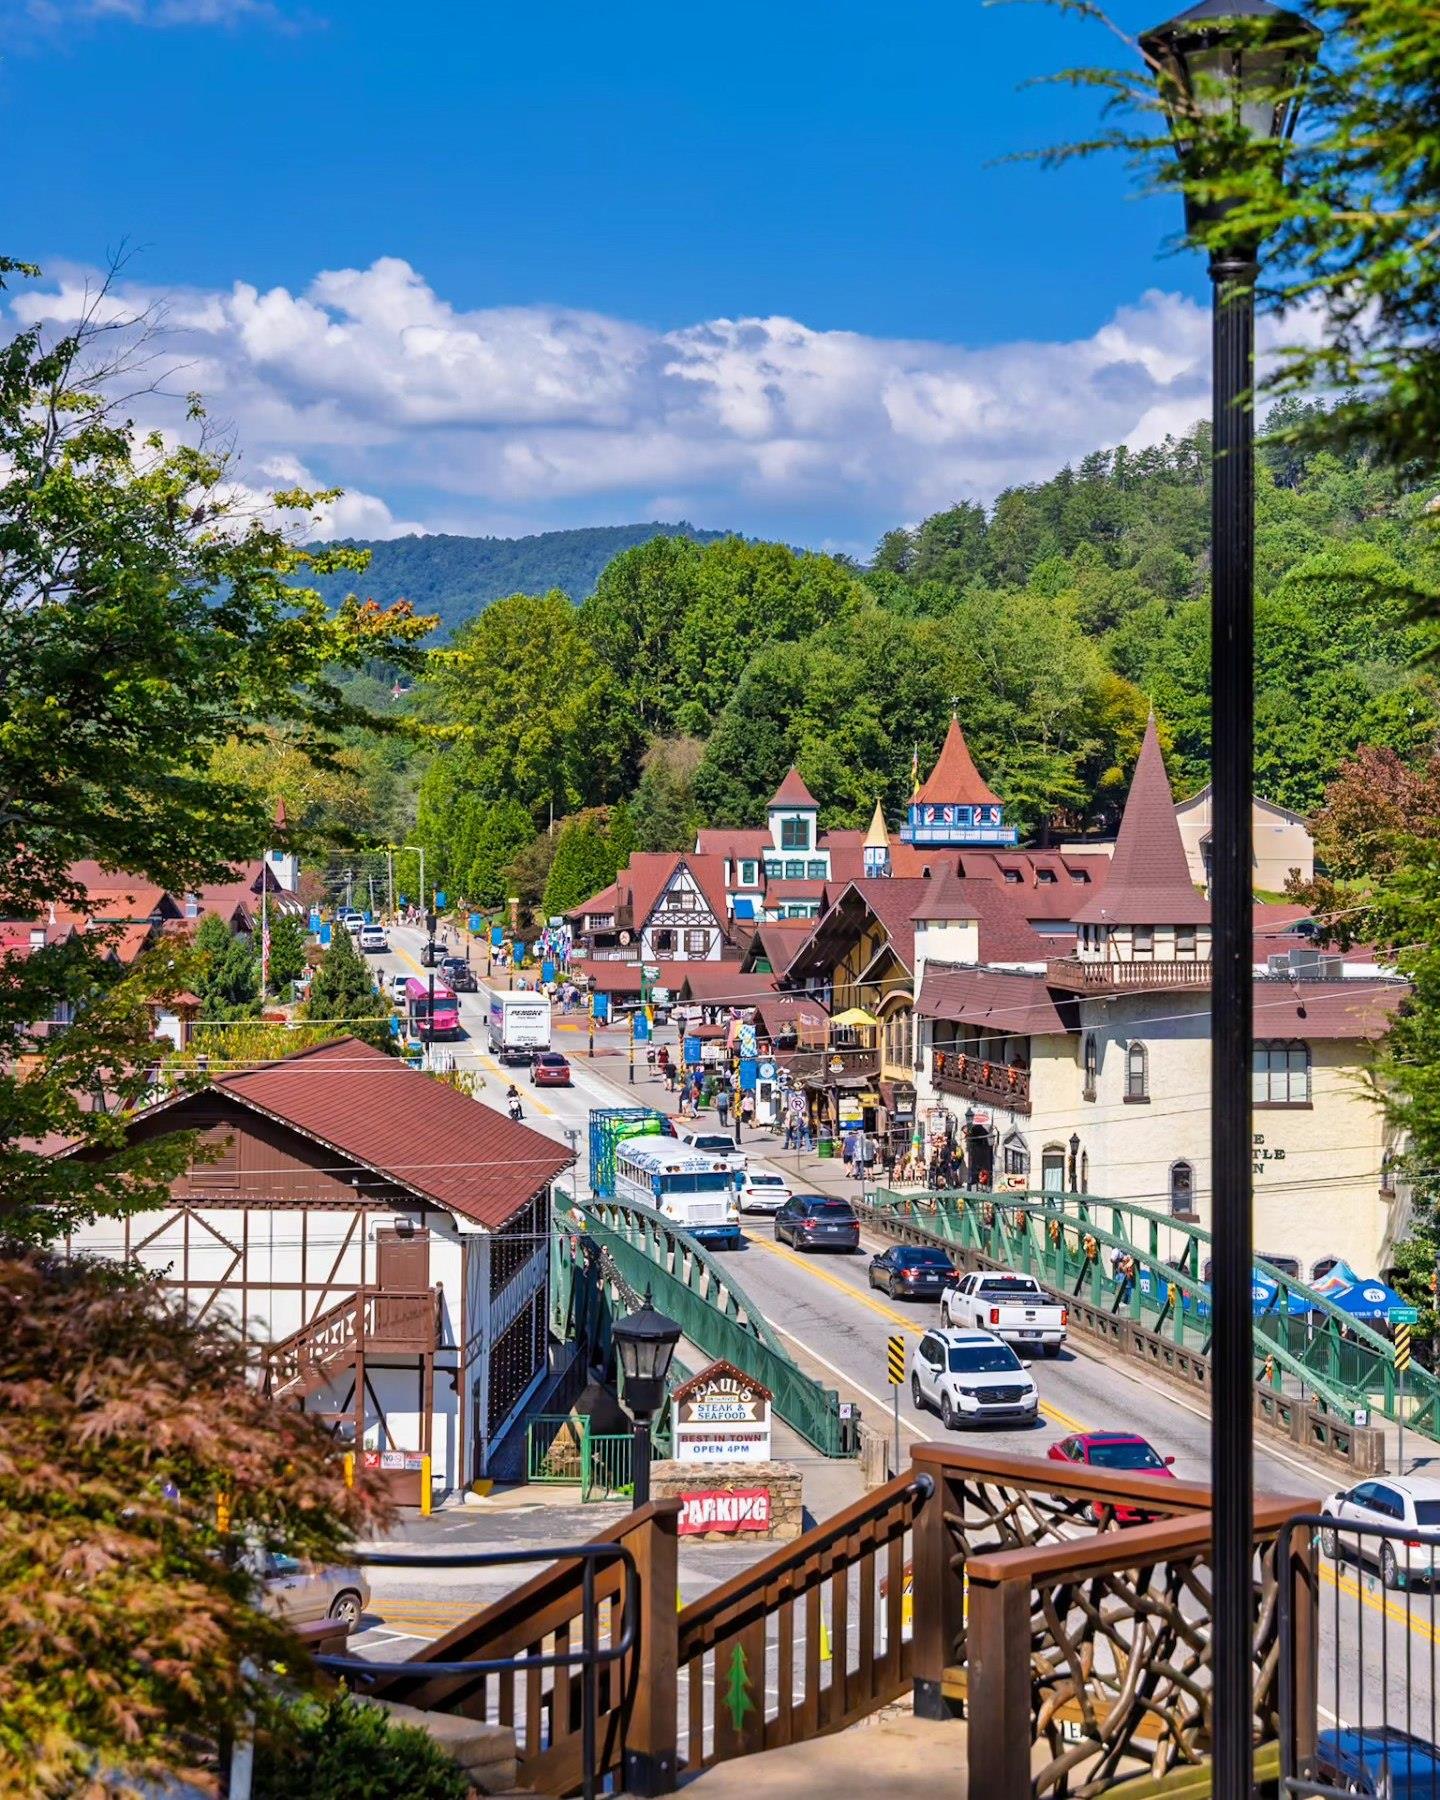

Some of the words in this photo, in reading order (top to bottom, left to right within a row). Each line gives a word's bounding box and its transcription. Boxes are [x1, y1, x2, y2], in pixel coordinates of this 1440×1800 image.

[691, 1378, 753, 1402] PAUL'S
[698, 1404, 733, 1412] STEAK
[737, 1404, 745, 1412] &
[698, 1412, 746, 1420] SEAFOOD
[681, 1434, 710, 1442] BEST
[714, 1434, 726, 1442] IN
[730, 1434, 761, 1442] TOWN
[693, 1445, 723, 1453] OPEN
[727, 1445, 750, 1453] 4PM
[677, 1496, 767, 1525] PARKING
